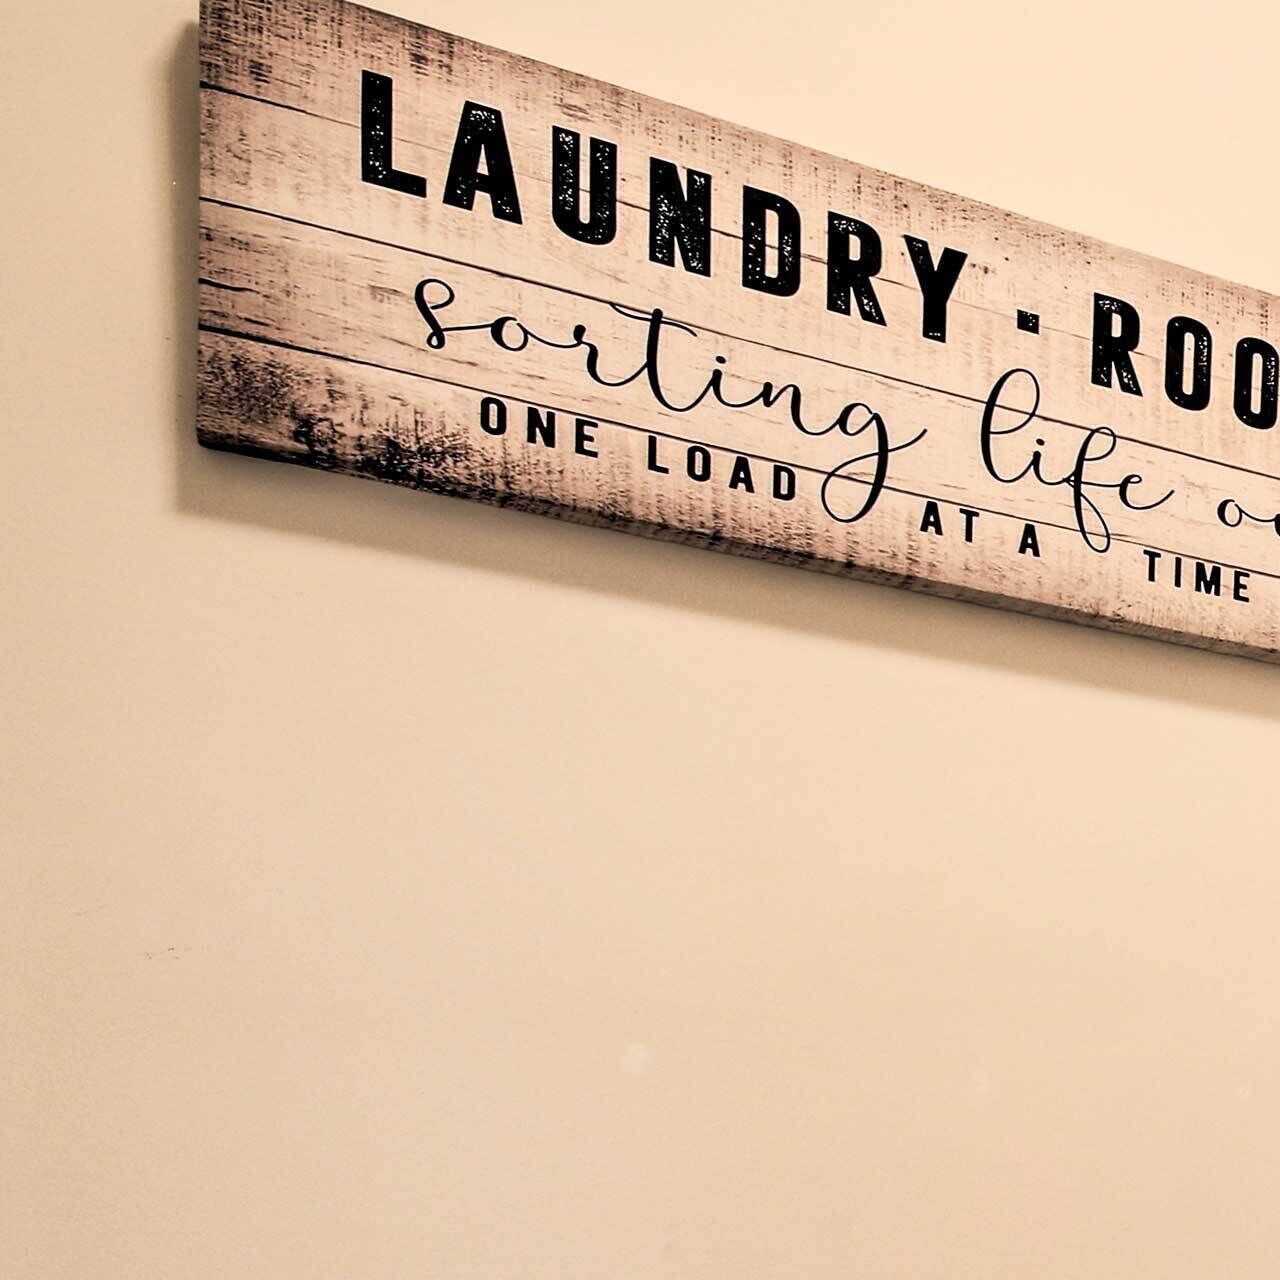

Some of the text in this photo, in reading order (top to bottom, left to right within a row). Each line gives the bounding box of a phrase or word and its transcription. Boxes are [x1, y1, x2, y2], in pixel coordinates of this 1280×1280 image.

[361, 69, 968, 343] LAUNDRY
[414, 279, 927, 523] sorting
[980, 369, 1174, 553] life
[480, 397, 1251, 603] ONE LOAD AT A TIME
